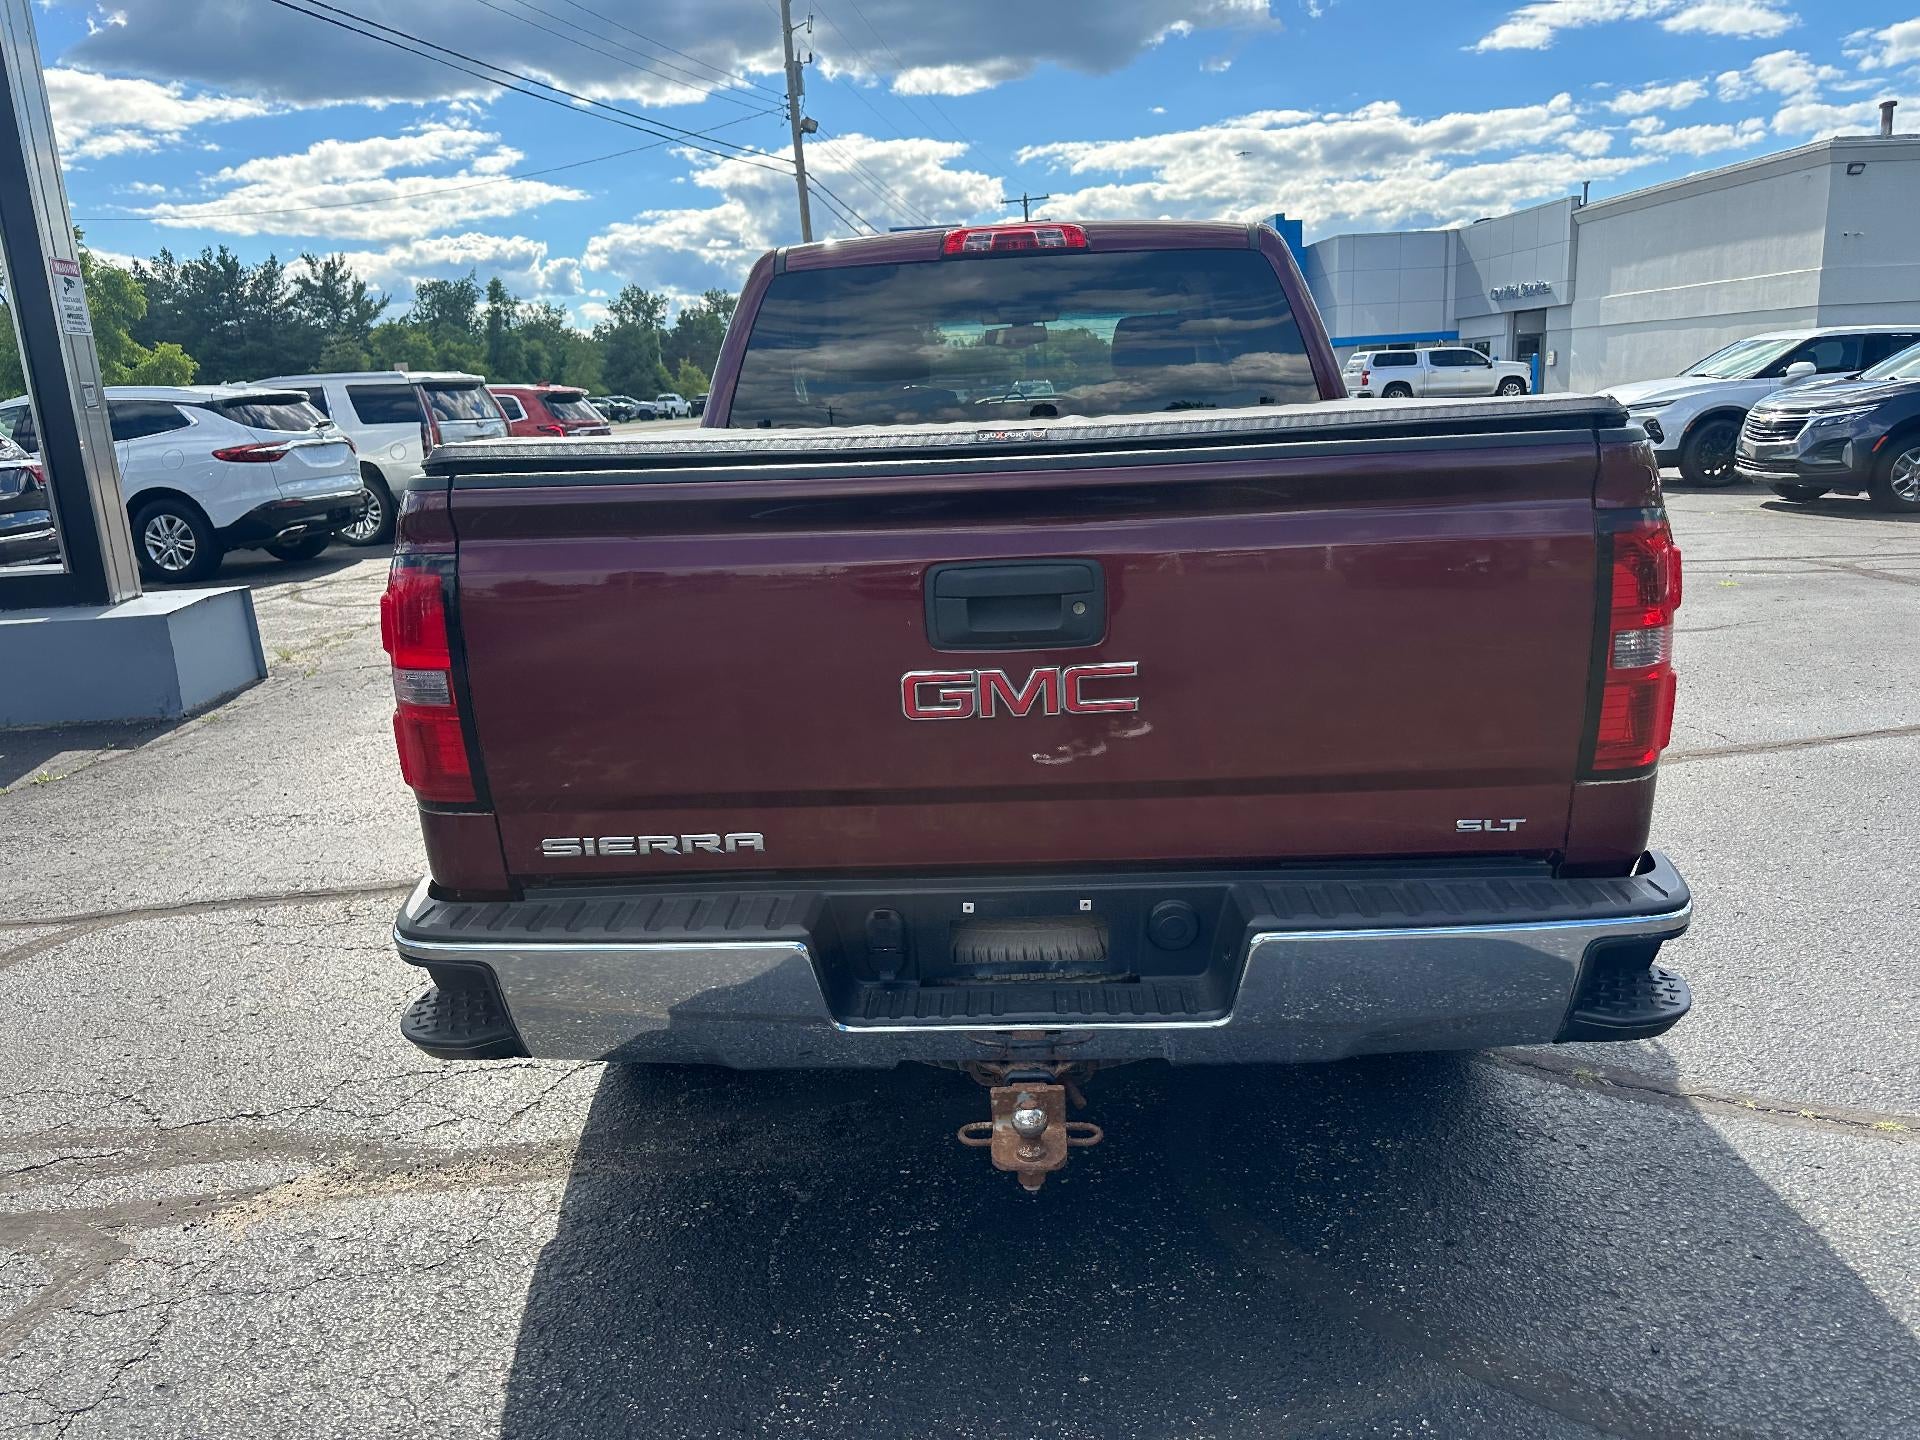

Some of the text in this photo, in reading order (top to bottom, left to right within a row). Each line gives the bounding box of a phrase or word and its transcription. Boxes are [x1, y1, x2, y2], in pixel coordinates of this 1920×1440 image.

[901, 661, 1139, 720] GMC
[1456, 819, 1527, 832] SLT
[541, 832, 766, 857] SIERRA
